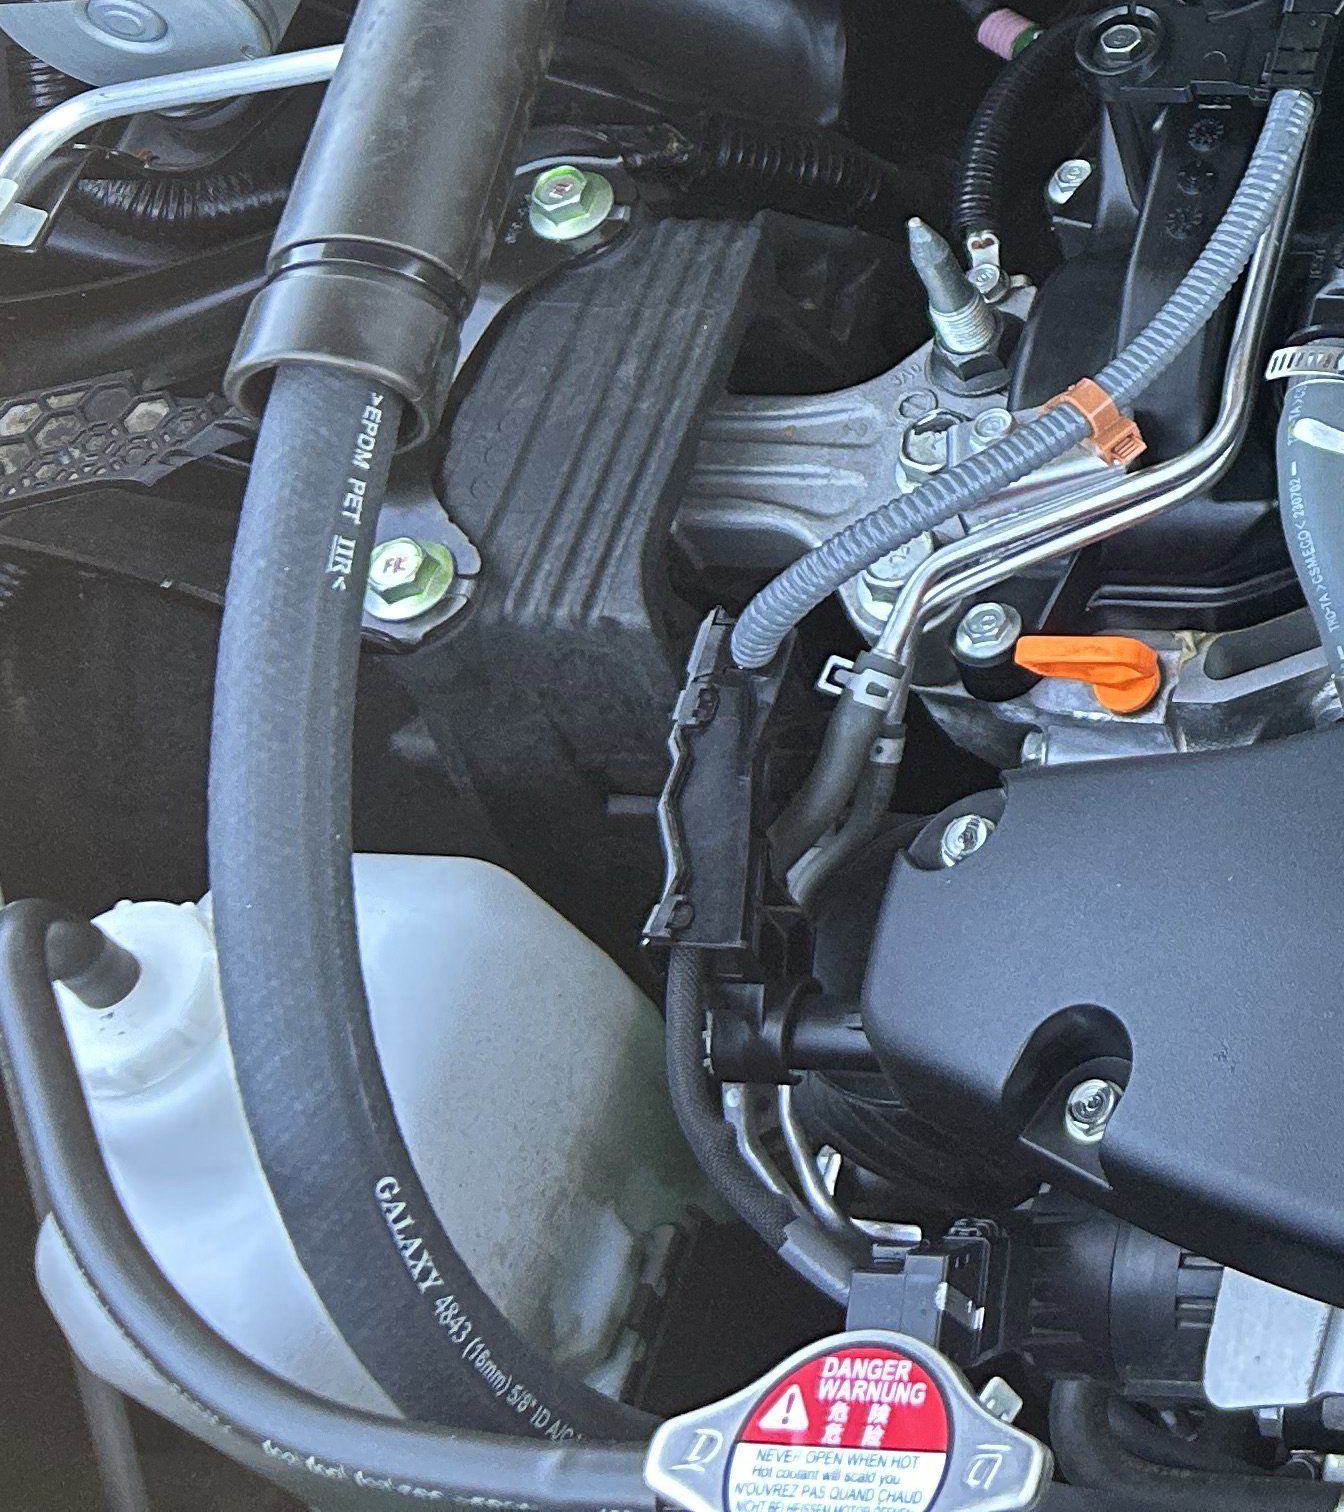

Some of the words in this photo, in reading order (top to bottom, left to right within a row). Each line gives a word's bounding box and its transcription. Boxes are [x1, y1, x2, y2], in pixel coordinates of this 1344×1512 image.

[340, 477, 367, 526] PET
[374, 1175, 445, 1295] GALAXY
[433, 1294, 472, 1344] 4843
[462, 1336, 513, 1398] (16mm)
[530, 1405, 550, 1428] ID
[821, 1356, 913, 1381] DANGER
[817, 1378, 927, 1406] WARNUNG
[806, 1450, 843, 1466] OPEN
[847, 1452, 887, 1468] WHEN
[890, 1454, 920, 1470] HOT
[752, 1466, 772, 1479] Hot
[821, 1469, 841, 1482] will
[844, 1470, 876, 1485] scald
[801, 1483, 826, 1500] PAS
[829, 1484, 875, 1502] QUAND
[877, 1487, 923, 1504] CHAUD
